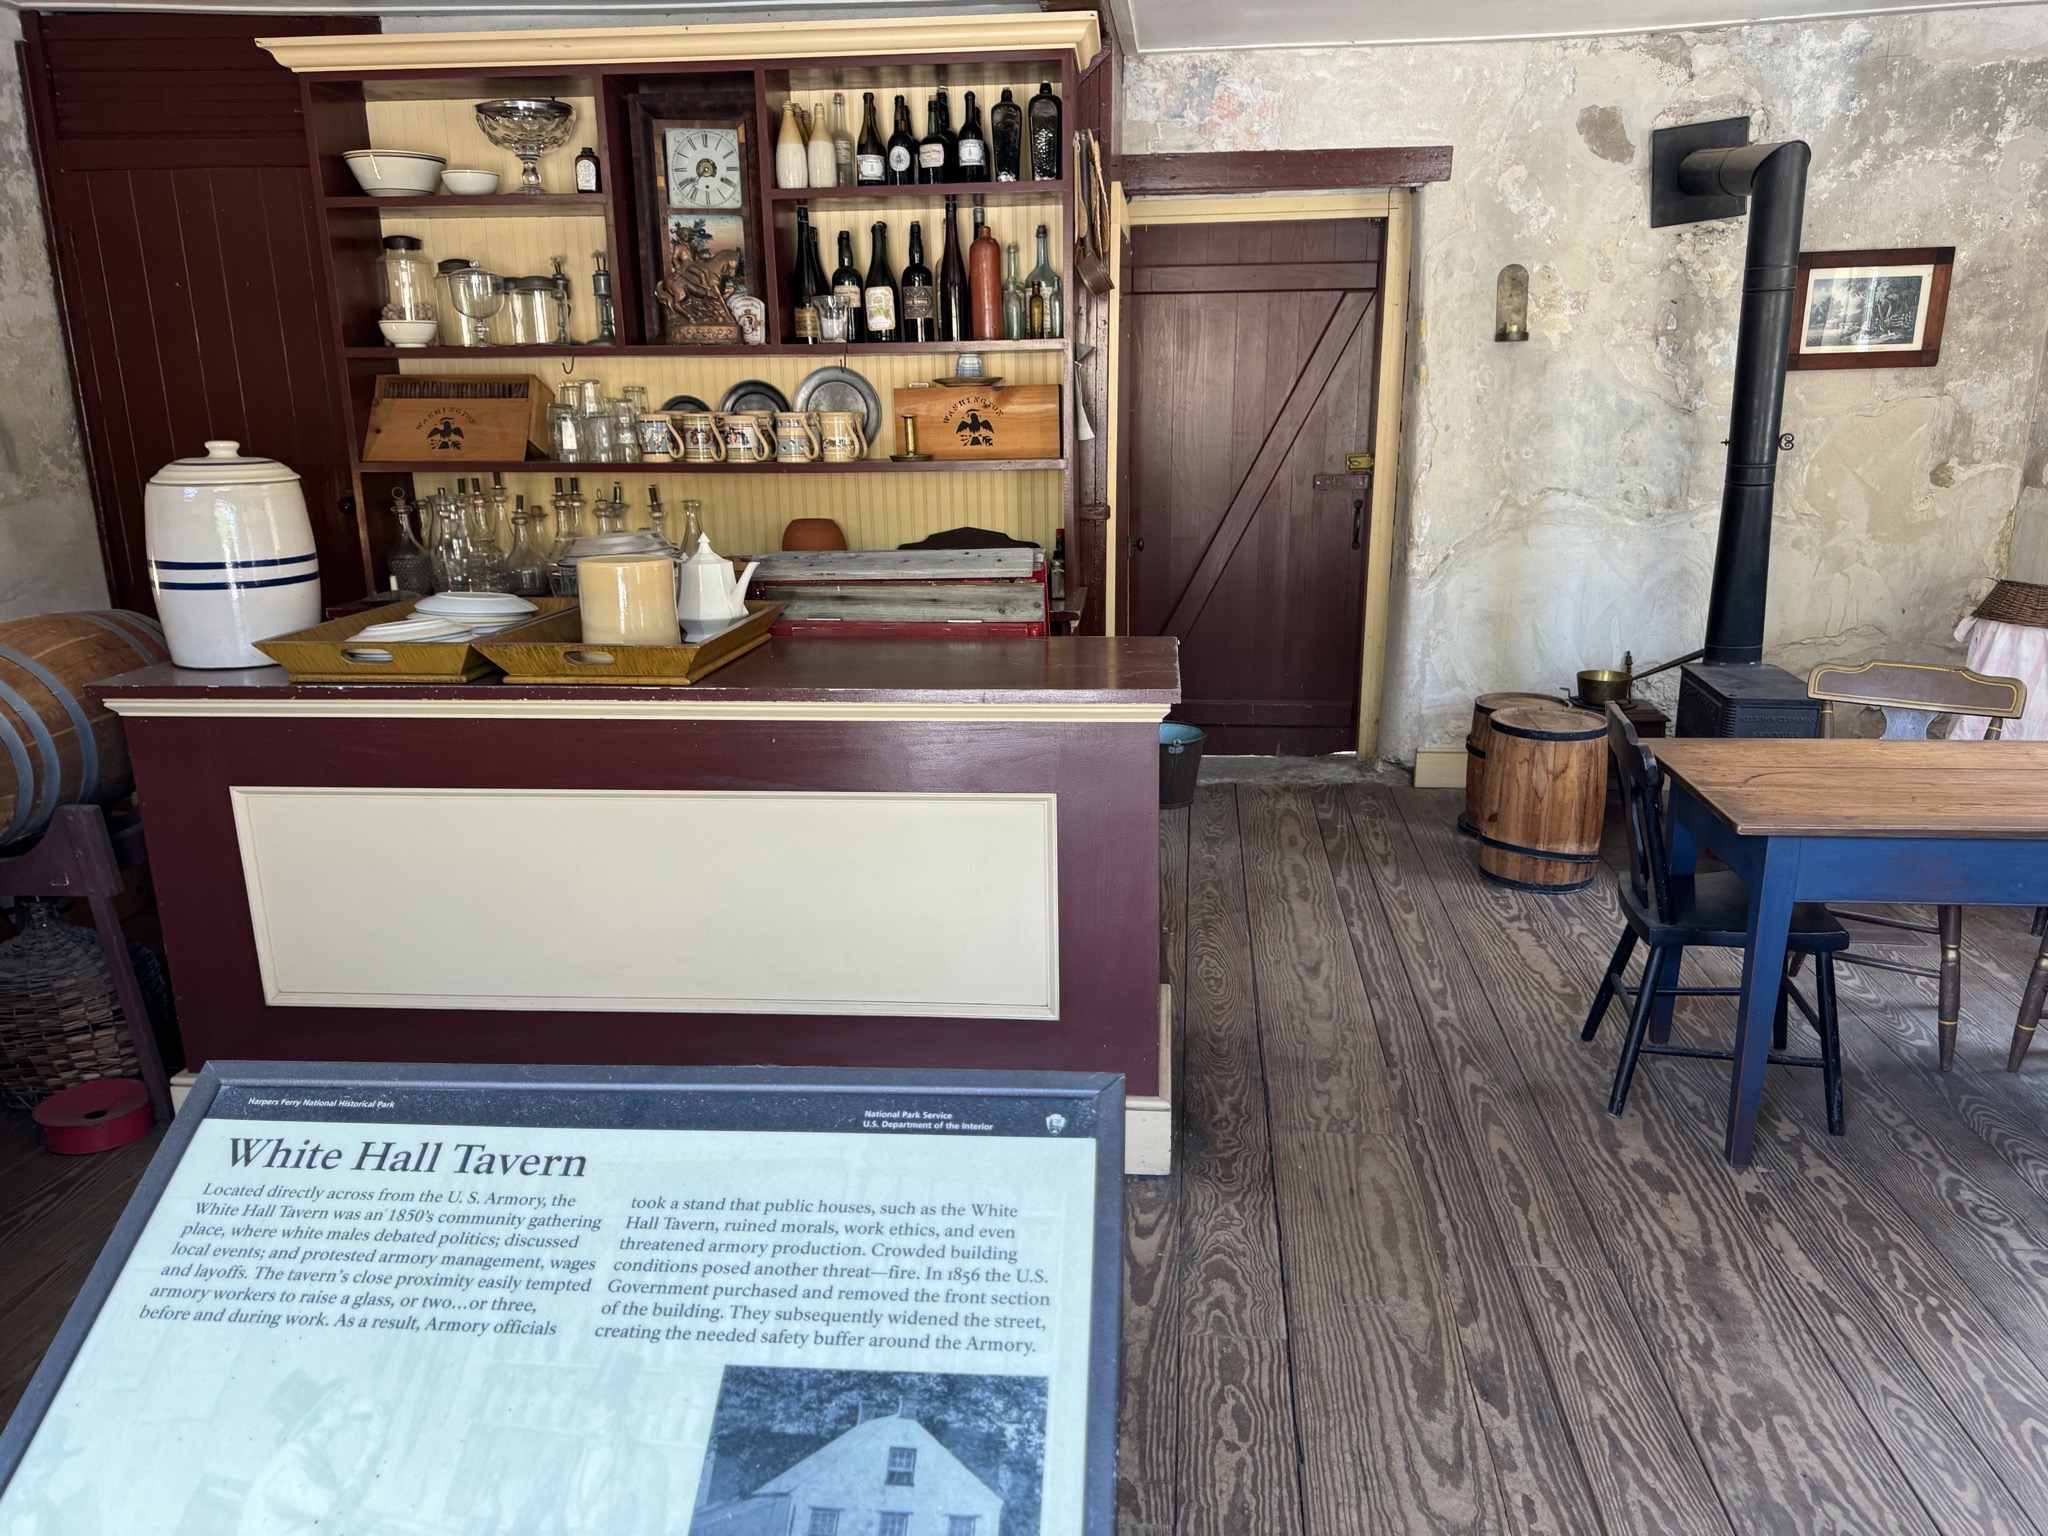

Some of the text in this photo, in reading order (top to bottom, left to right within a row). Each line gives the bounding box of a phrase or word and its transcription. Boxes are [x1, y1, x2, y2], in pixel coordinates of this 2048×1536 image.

[416, 406, 477, 430] WASHINGTON
[942, 395, 1005, 424] WASHINGTON
[247, 1097, 396, 1108] Harpers Ferry National Historical Park
[864, 1110, 953, 1120] National Park Service
[863, 1120, 994, 1130] U.S. Department of the Interior
[230, 1137, 587, 1177] White Hall Tavern
[202, 1183, 266, 1197] Located
[267, 1185, 325, 1203] directly
[326, 1190, 375, 1201] across
[377, 1188, 415, 1202] from
[419, 1189, 443, 1203] the
[483, 1192, 546, 1210] Armory,
[551, 1194, 576, 1207] the
[631, 1196, 1018, 1218] took a stand that public houses, such as the White
[196, 1202, 239, 1216] White
[241, 1204, 277, 1217] Hall
[279, 1205, 329, 1219] Tavern
[334, 1210, 362, 1220] was
[364, 1210, 383, 1221] an
[438, 1212, 526, 1230] community
[526, 1213, 603, 1232] gathering
[625, 1216, 1015, 1239] Hall Tavern, ruined morals, work ethics, and even
[179, 1222, 580, 1248] place, where white males debated politics; discussed
[171, 1241, 597, 1274] local events; and protested armory management, wages
[619, 1236, 1018, 1265] threatened armory production. Crowded building
[160, 1263, 194, 1277] and
[194, 1263, 248, 1282] layoffs.
[254, 1266, 284, 1280] The
[352, 1270, 393, 1285] close
[393, 1272, 475, 1292] proximity
[477, 1275, 523, 1294] easily
[525, 1278, 592, 1295] tempted
[613, 1258, 698, 1274] conditions
[700, 1261, 751, 1278] posed
[754, 1262, 819, 1277] another
[925, 1266, 942, 1280] In
[947, 1267, 980, 1285] 1856
[985, 1268, 1011, 1283] the
[1016, 1269, 1048, 1283] U.S.
[149, 1287, 212, 1303] armory
[214, 1287, 277, 1302] workers
[279, 1290, 296, 1303] to
[298, 1290, 338, 1304] raise
[340, 1295, 350, 1305] a
[351, 1291, 394, 1310] glass,
[400, 1297, 419, 1307] or
[491, 1297, 536, 1315] three,
[607, 1278, 1050, 1306] Government purchased and removed the front section
[139, 1304, 557, 1337] before and during work. As a result, Armory officials
[601, 1300, 1046, 1331] of the building. They subsequently widened the street,
[594, 1324, 1036, 1357] creating the needed safety buffer around the Armory.
